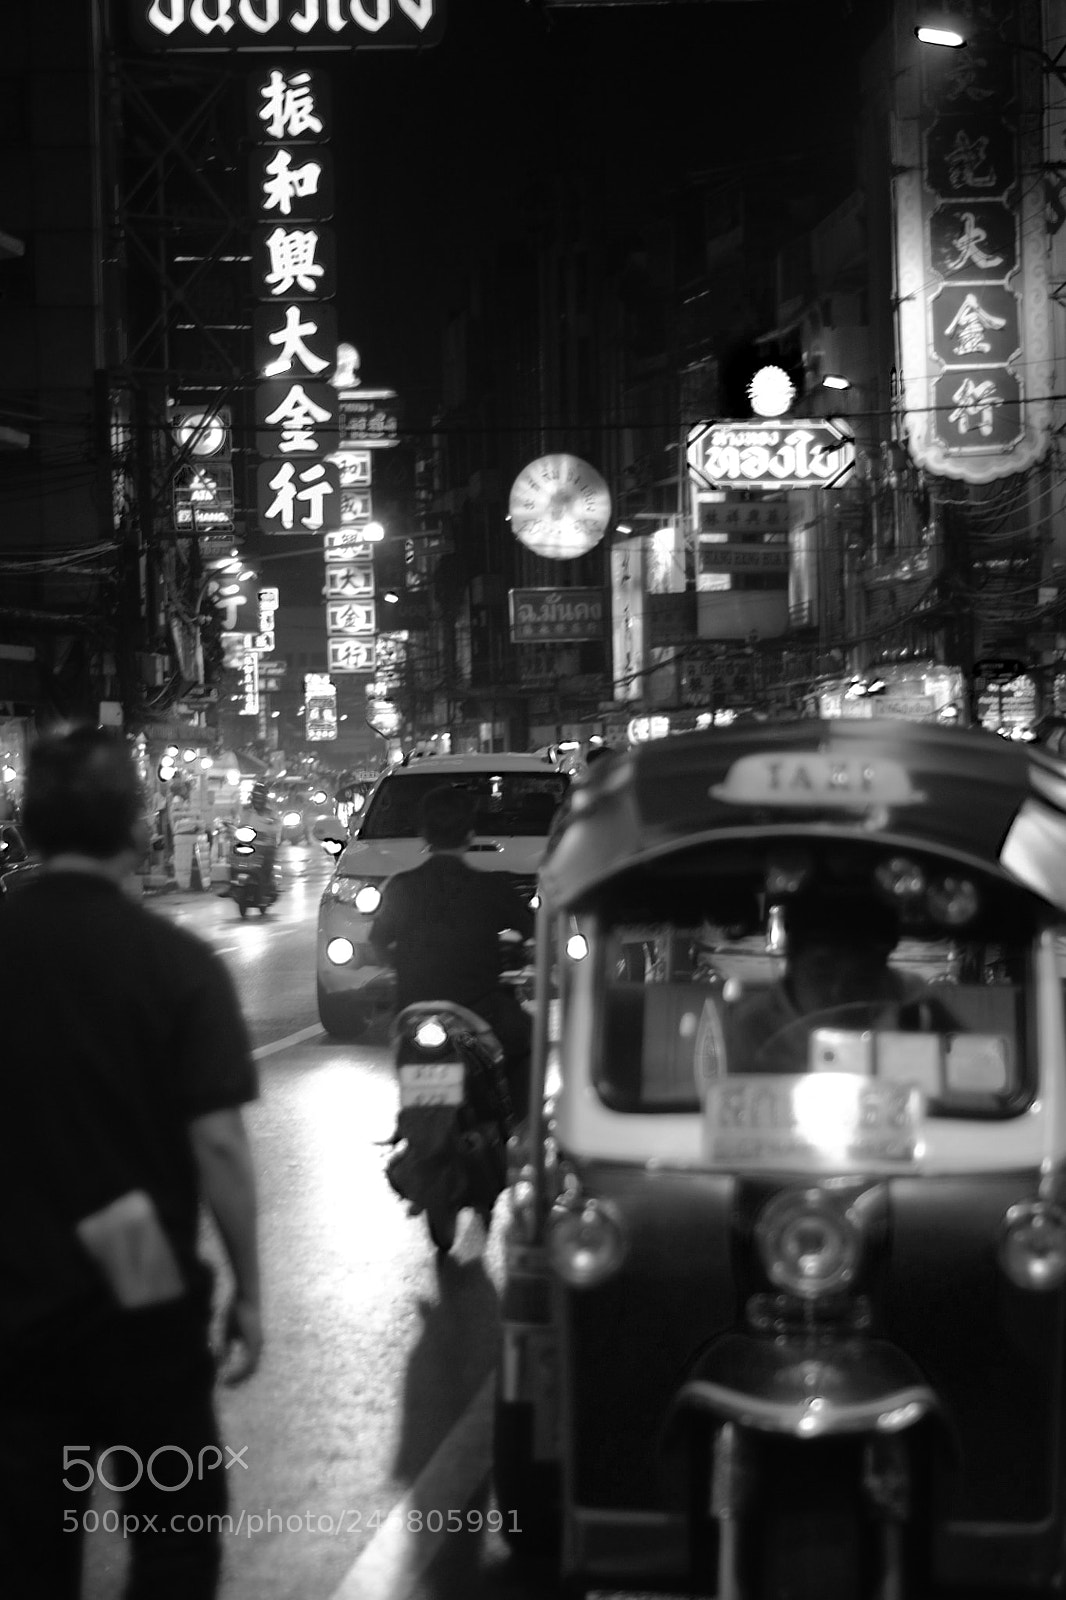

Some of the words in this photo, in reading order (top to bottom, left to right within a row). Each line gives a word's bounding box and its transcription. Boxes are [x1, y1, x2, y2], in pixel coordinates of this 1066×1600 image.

[259, 69, 334, 532] 振和興大金行
